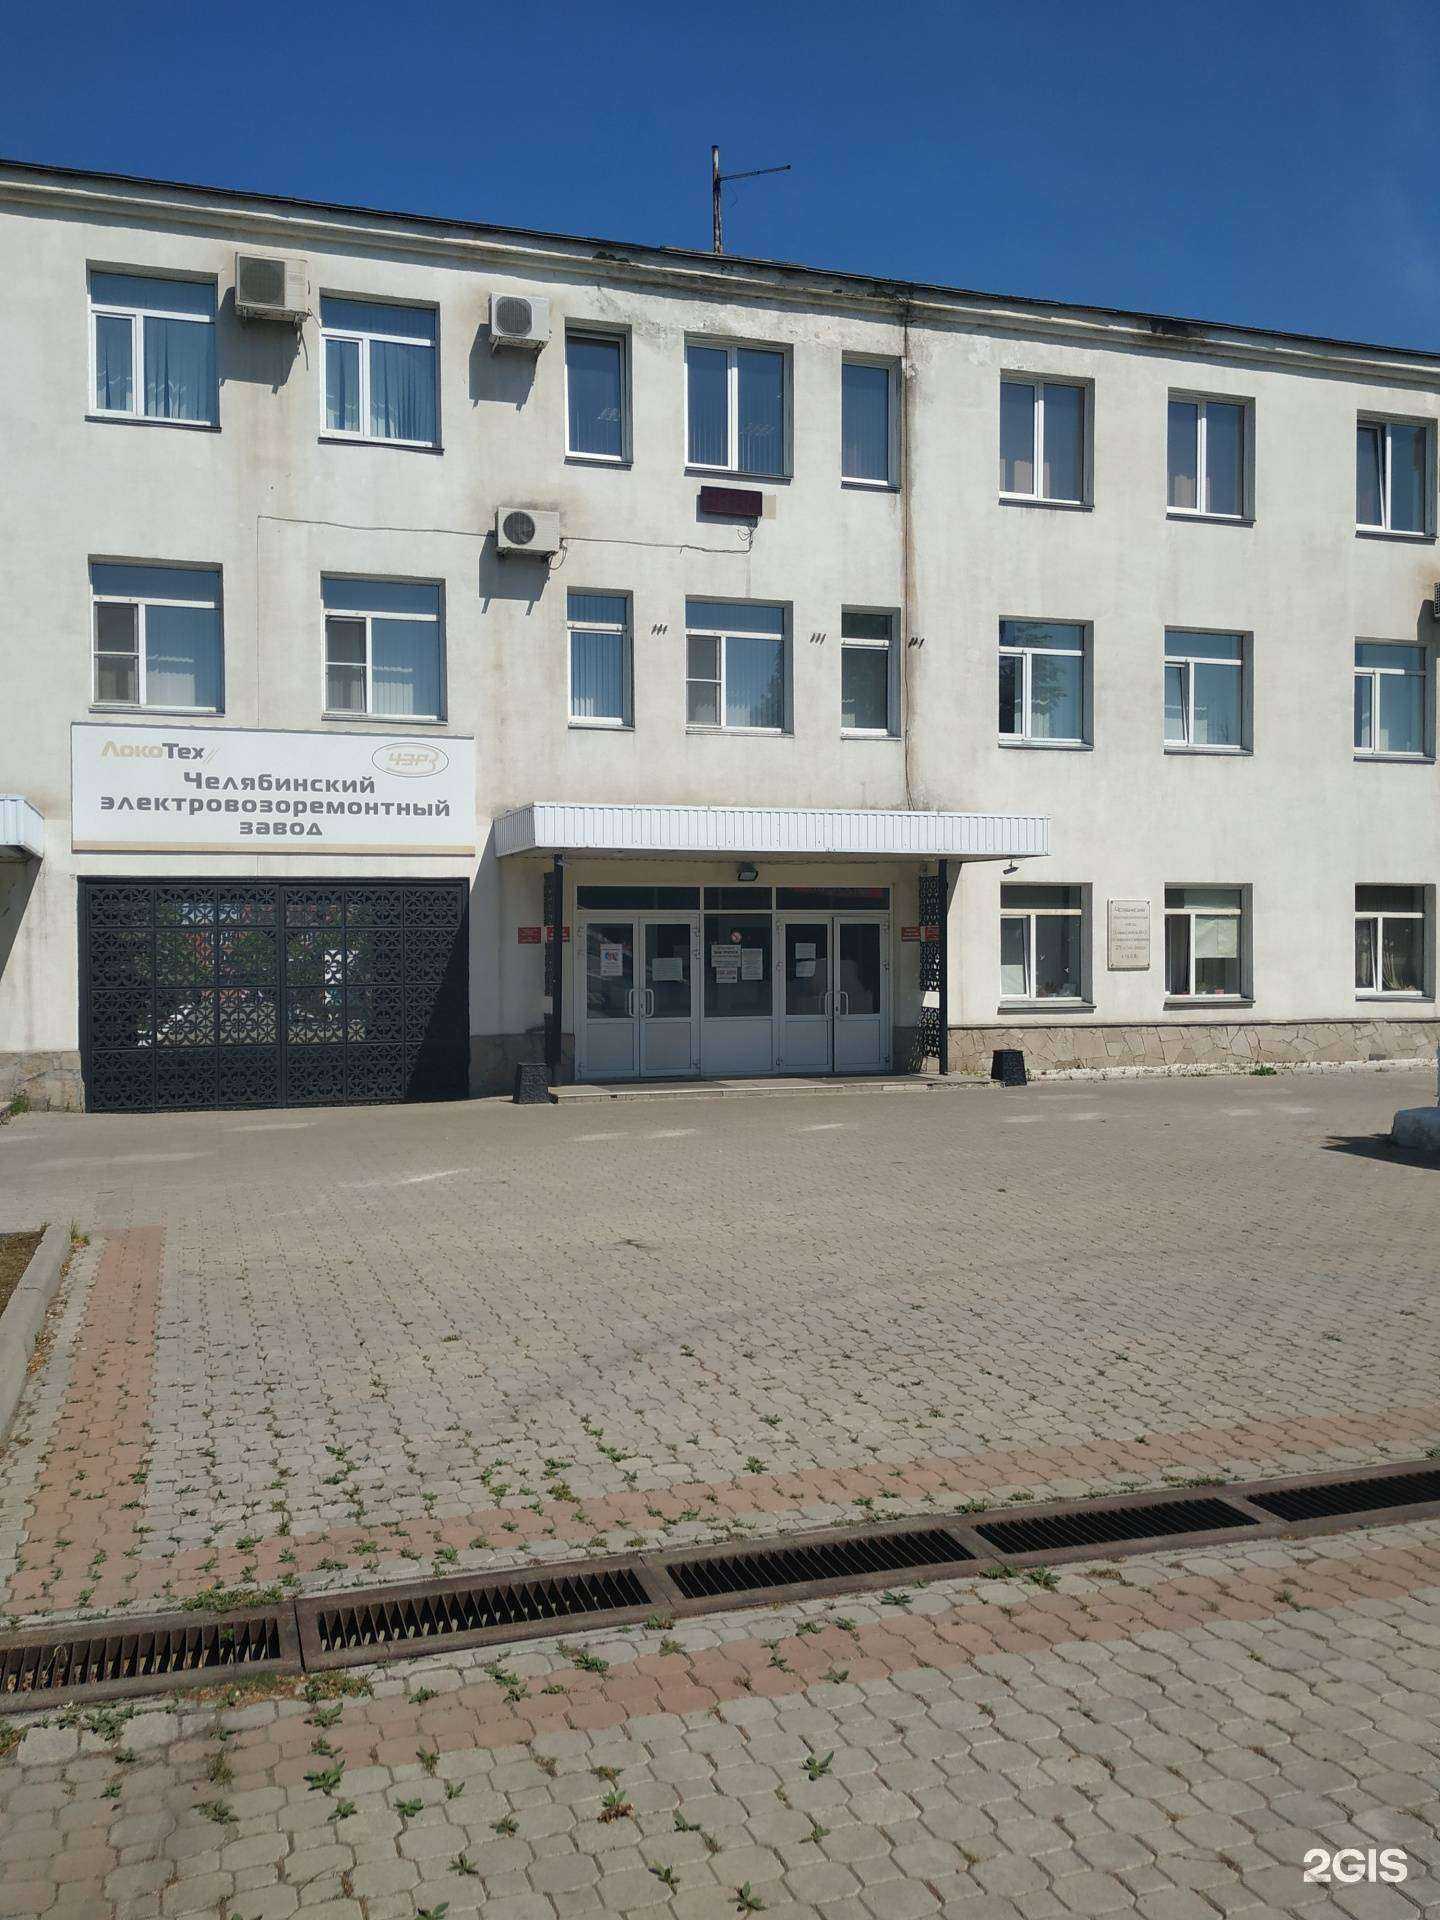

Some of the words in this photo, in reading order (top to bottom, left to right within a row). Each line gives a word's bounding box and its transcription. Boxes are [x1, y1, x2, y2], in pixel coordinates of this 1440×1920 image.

[101, 740, 205, 760] ЛокоТех
[184, 771, 375, 794] Челябинский
[100, 794, 451, 818] электровозоремонтный
[240, 820, 323, 837] завод
